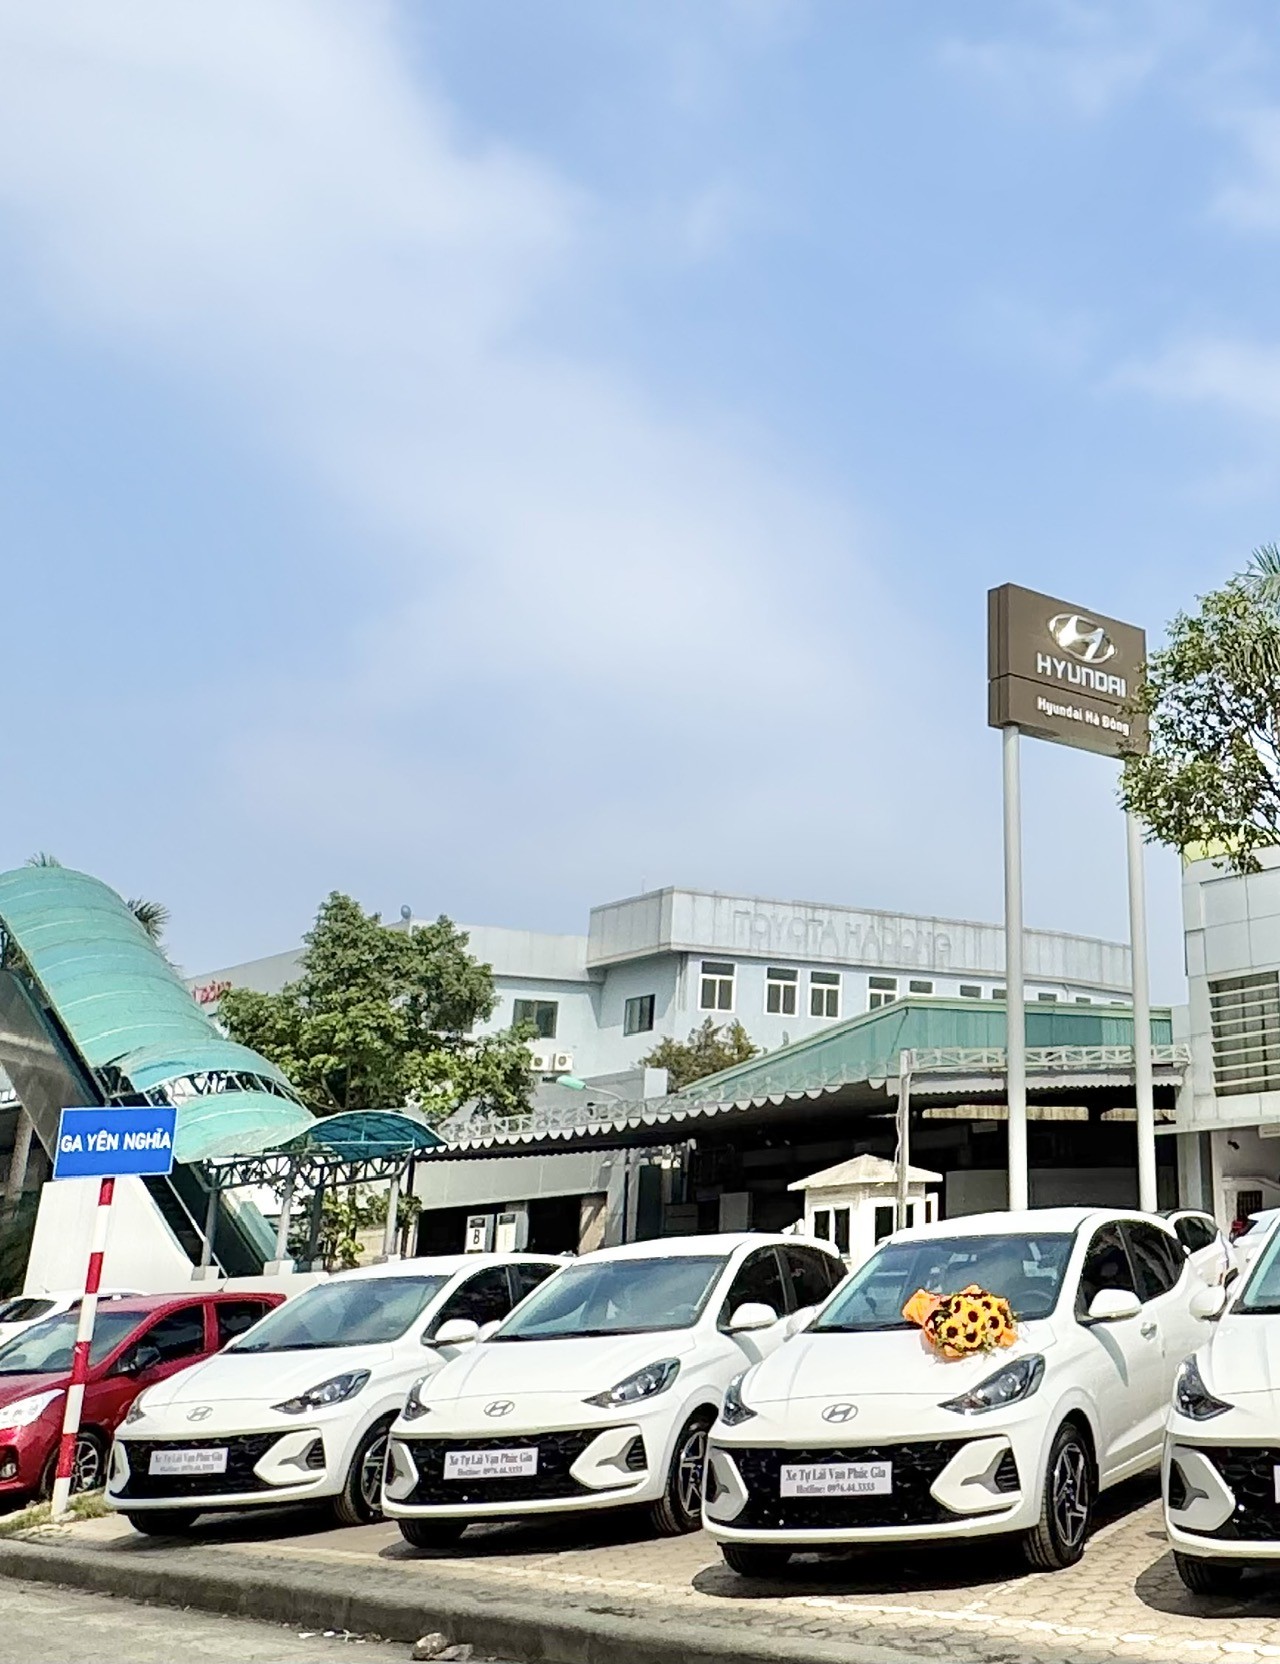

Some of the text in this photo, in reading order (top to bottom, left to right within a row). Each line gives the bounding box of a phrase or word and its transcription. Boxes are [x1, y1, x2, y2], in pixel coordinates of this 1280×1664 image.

[1036, 652, 1127, 699] HYUNDAI
[1037, 696, 1083, 721] Hyundai
[1085, 710, 1100, 726] Hà
[60, 1128, 172, 1153] GA YÊN NGHĨA
